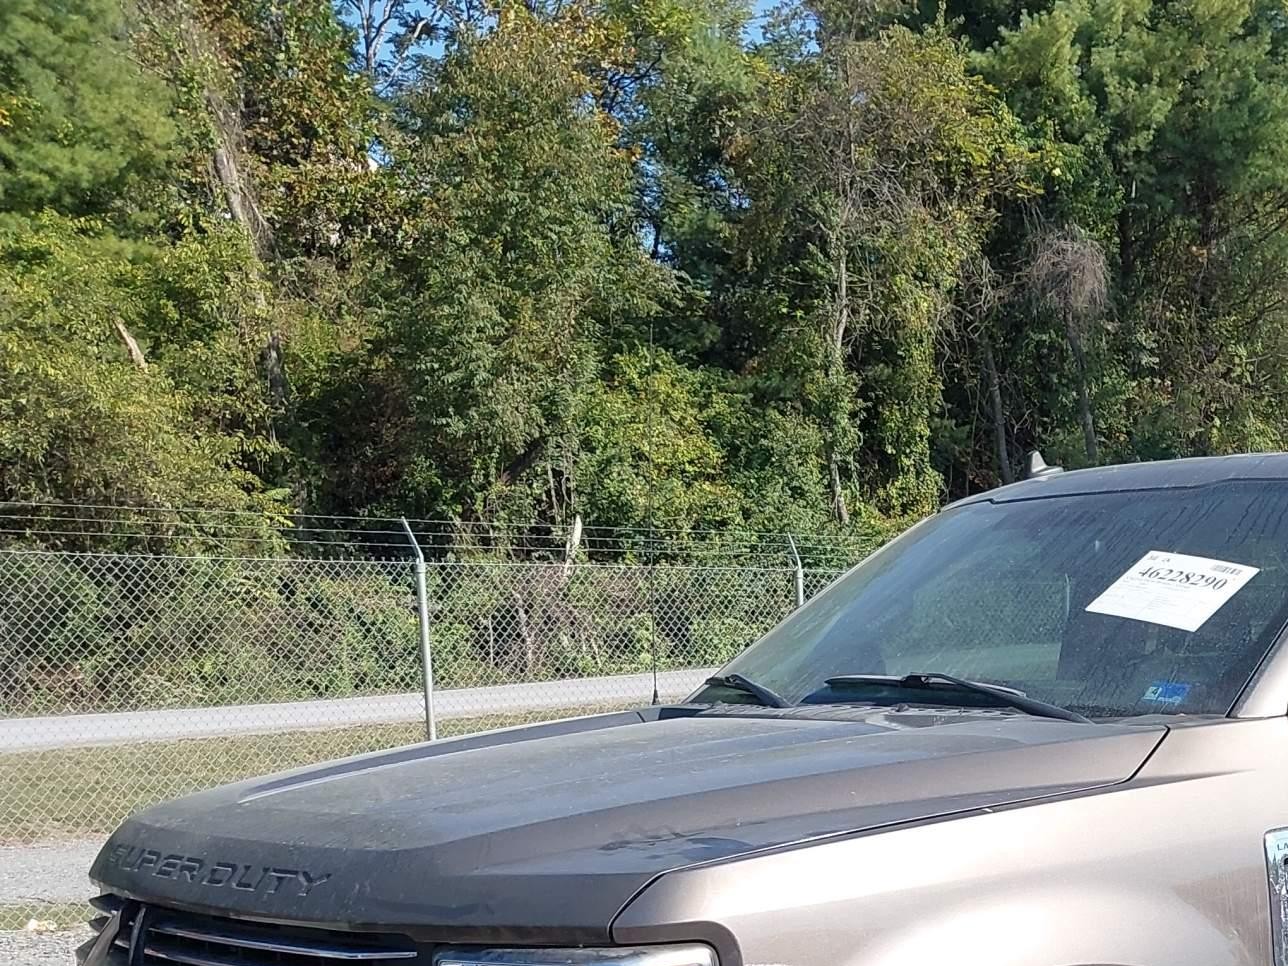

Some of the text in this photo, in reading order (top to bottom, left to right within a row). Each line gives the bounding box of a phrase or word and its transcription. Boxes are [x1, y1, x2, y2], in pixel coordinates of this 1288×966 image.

[1138, 566, 1228, 591] 46228290
[109, 844, 332, 897] SUPER DUTY
